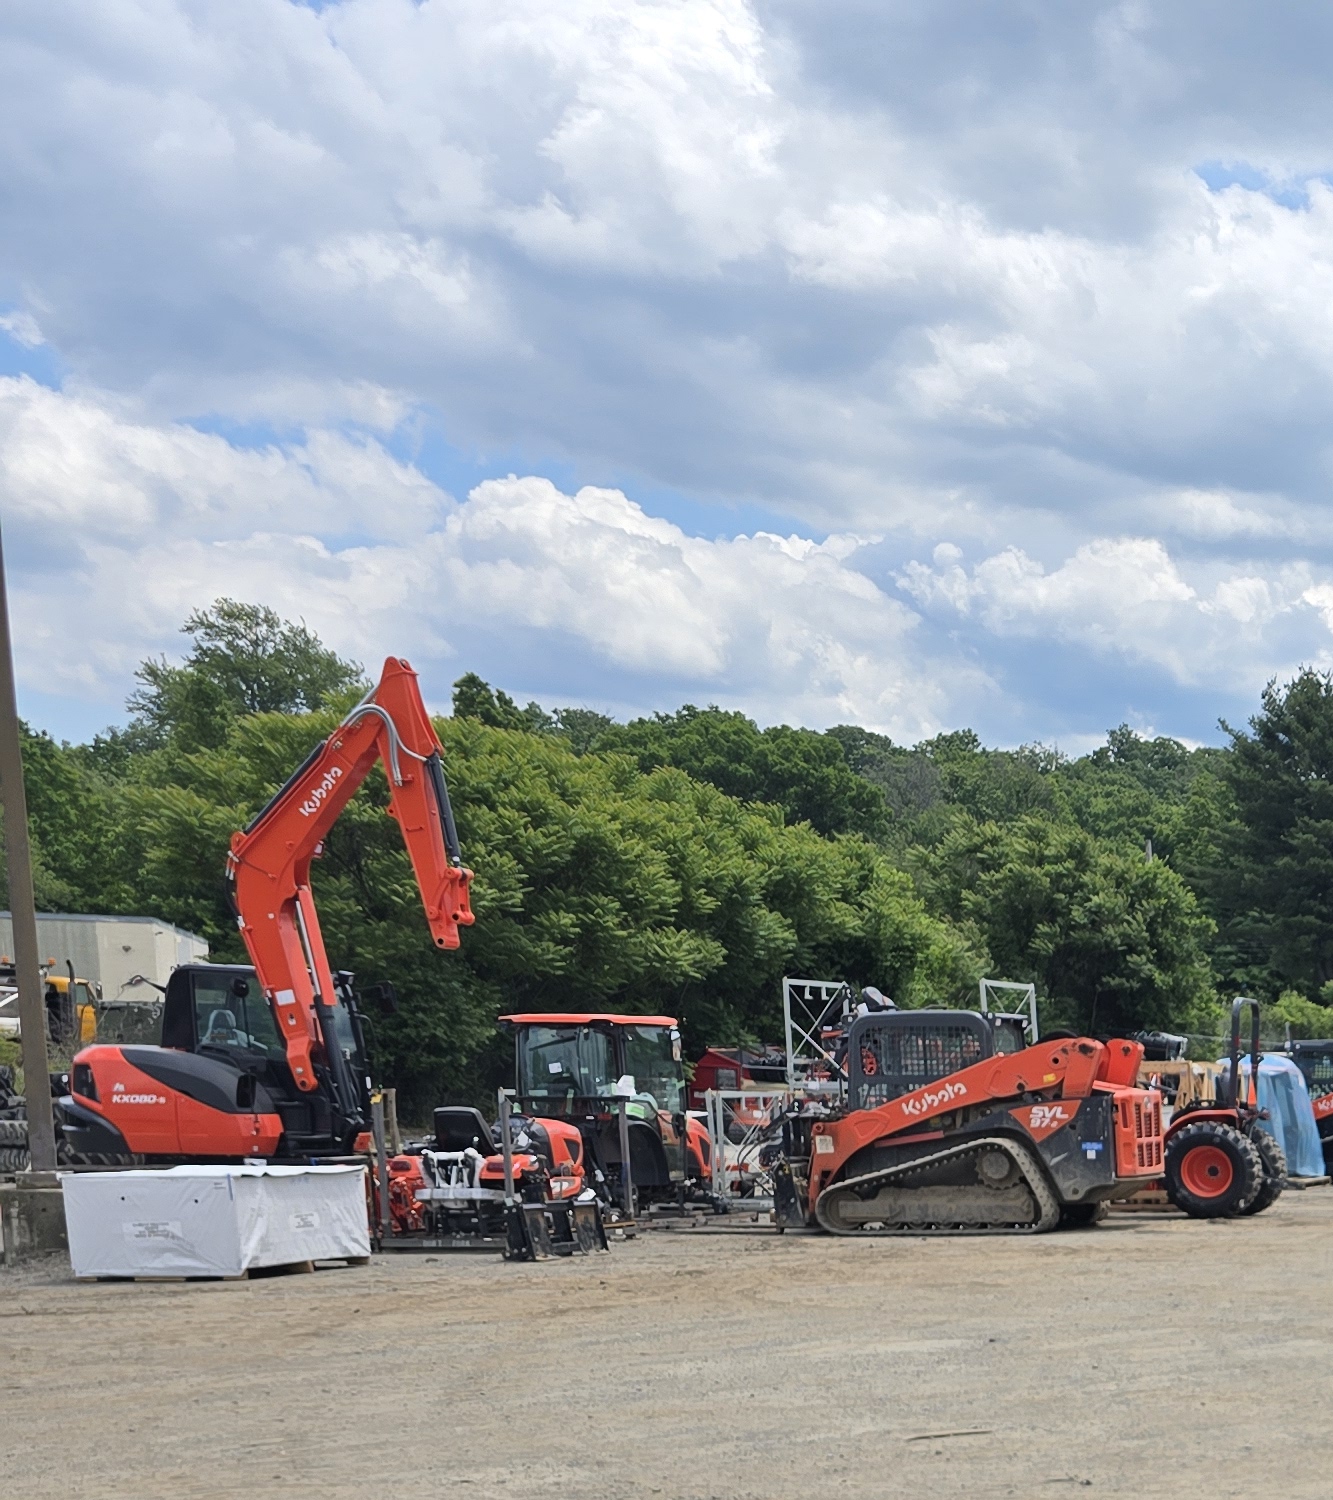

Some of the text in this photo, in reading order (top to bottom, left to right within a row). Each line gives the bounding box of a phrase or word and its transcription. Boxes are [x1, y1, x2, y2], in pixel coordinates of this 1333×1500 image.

[298, 766, 343, 817] Kubota
[901, 1082, 967, 1116] Kubota
[1030, 1105, 1069, 1118] SVL
